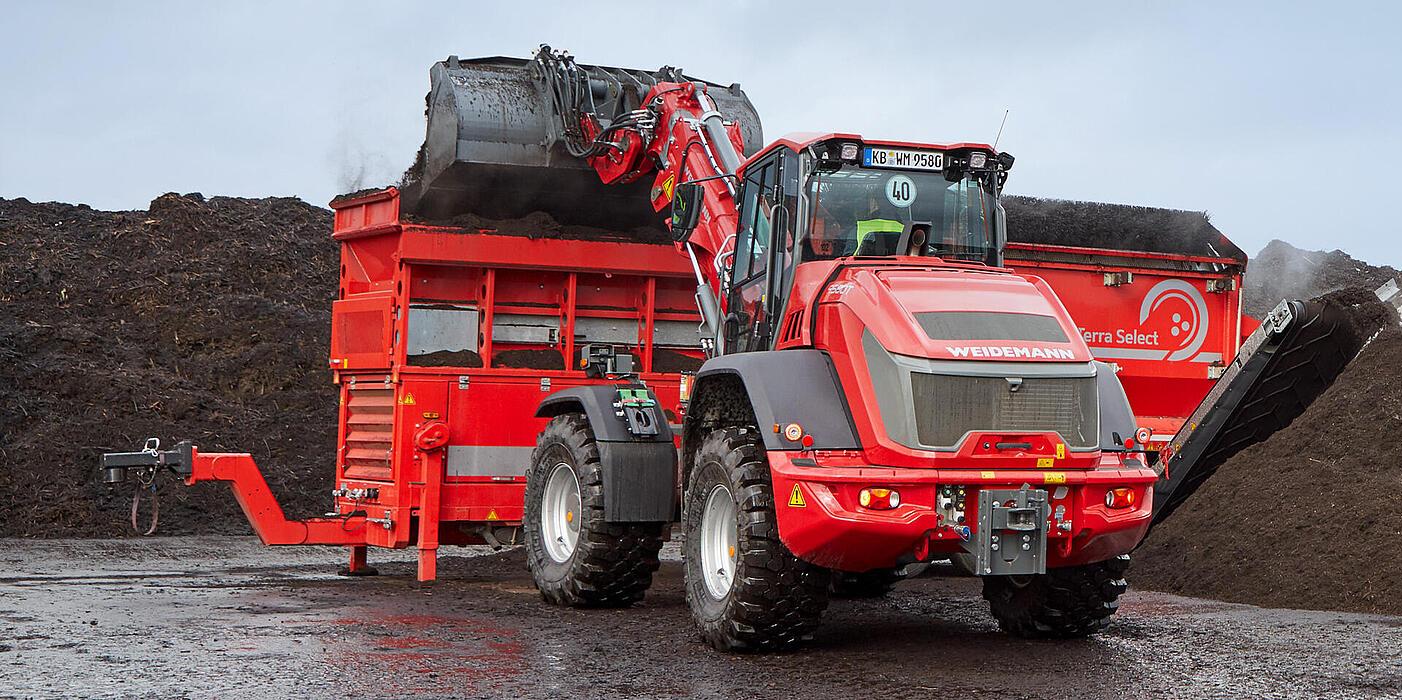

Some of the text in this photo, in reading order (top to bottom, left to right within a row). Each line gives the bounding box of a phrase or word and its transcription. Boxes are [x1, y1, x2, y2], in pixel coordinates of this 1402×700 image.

[872, 150, 942, 168] KB WM 9580
[892, 181, 910, 201] 40
[1116, 328, 1159, 345] Select
[945, 346, 1075, 360] WEIDEMANN
